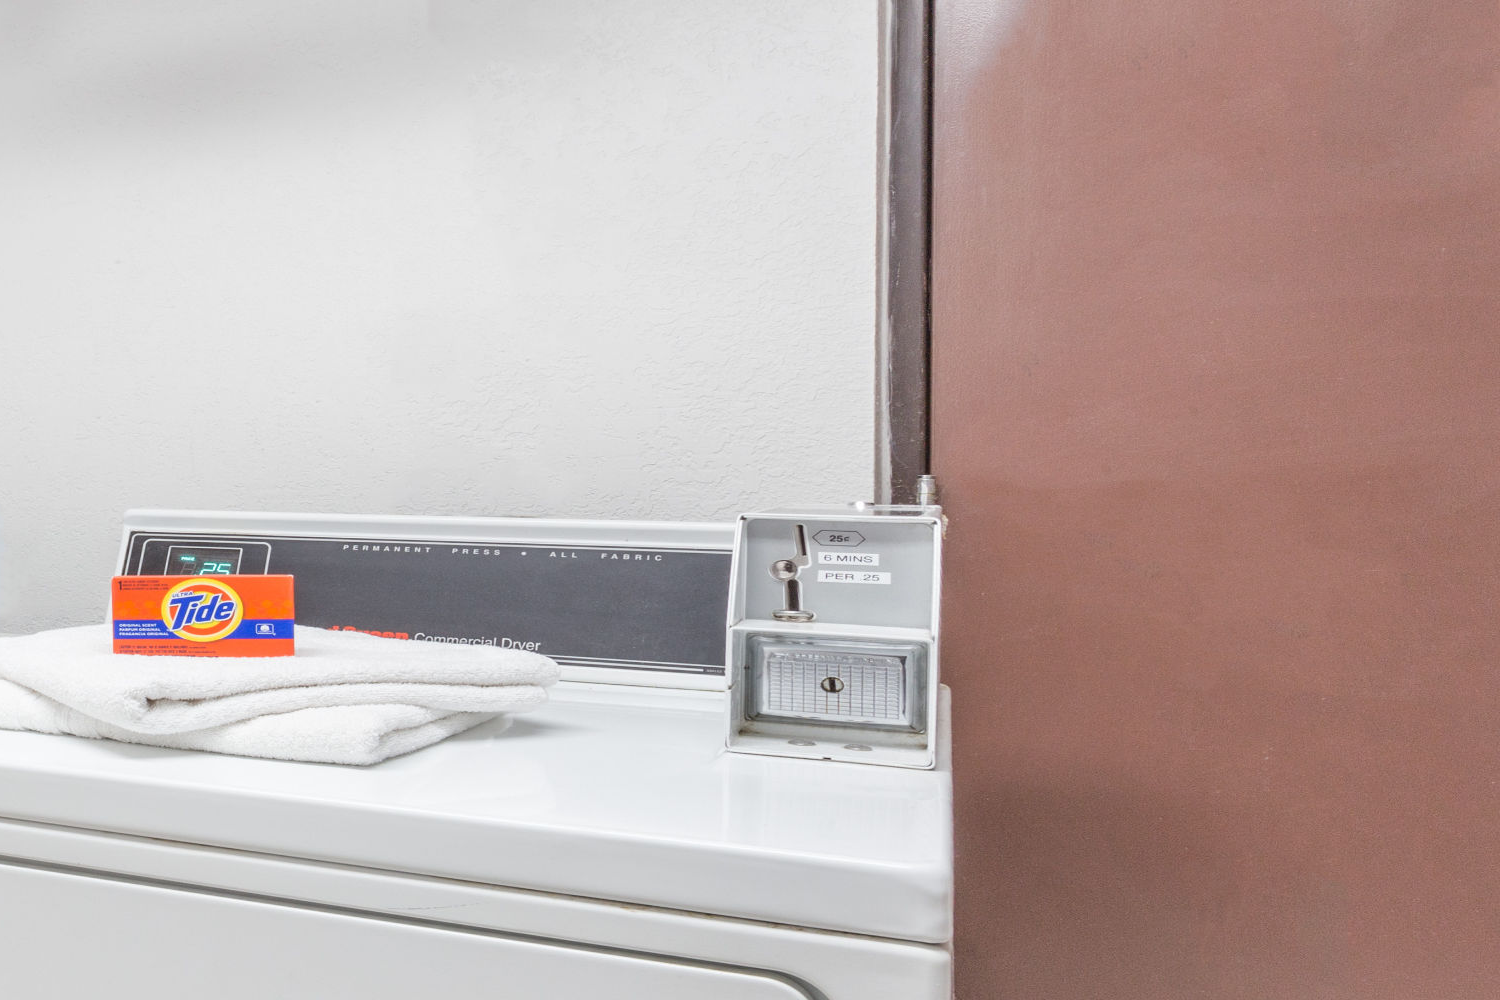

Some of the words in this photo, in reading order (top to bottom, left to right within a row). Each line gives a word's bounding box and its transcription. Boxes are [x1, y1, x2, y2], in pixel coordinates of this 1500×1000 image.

[343, 544, 432, 554] PERMANENT
[452, 547, 501, 556] PRESS
[549, 551, 578, 559] ALL
[601, 553, 662, 561] FABRIC
[823, 554, 832, 562] 6
[836, 555, 873, 563] MINS
[825, 572, 854, 580] PER
[169, 594, 235, 632] Tide
[501, 637, 541, 652] Dryer
